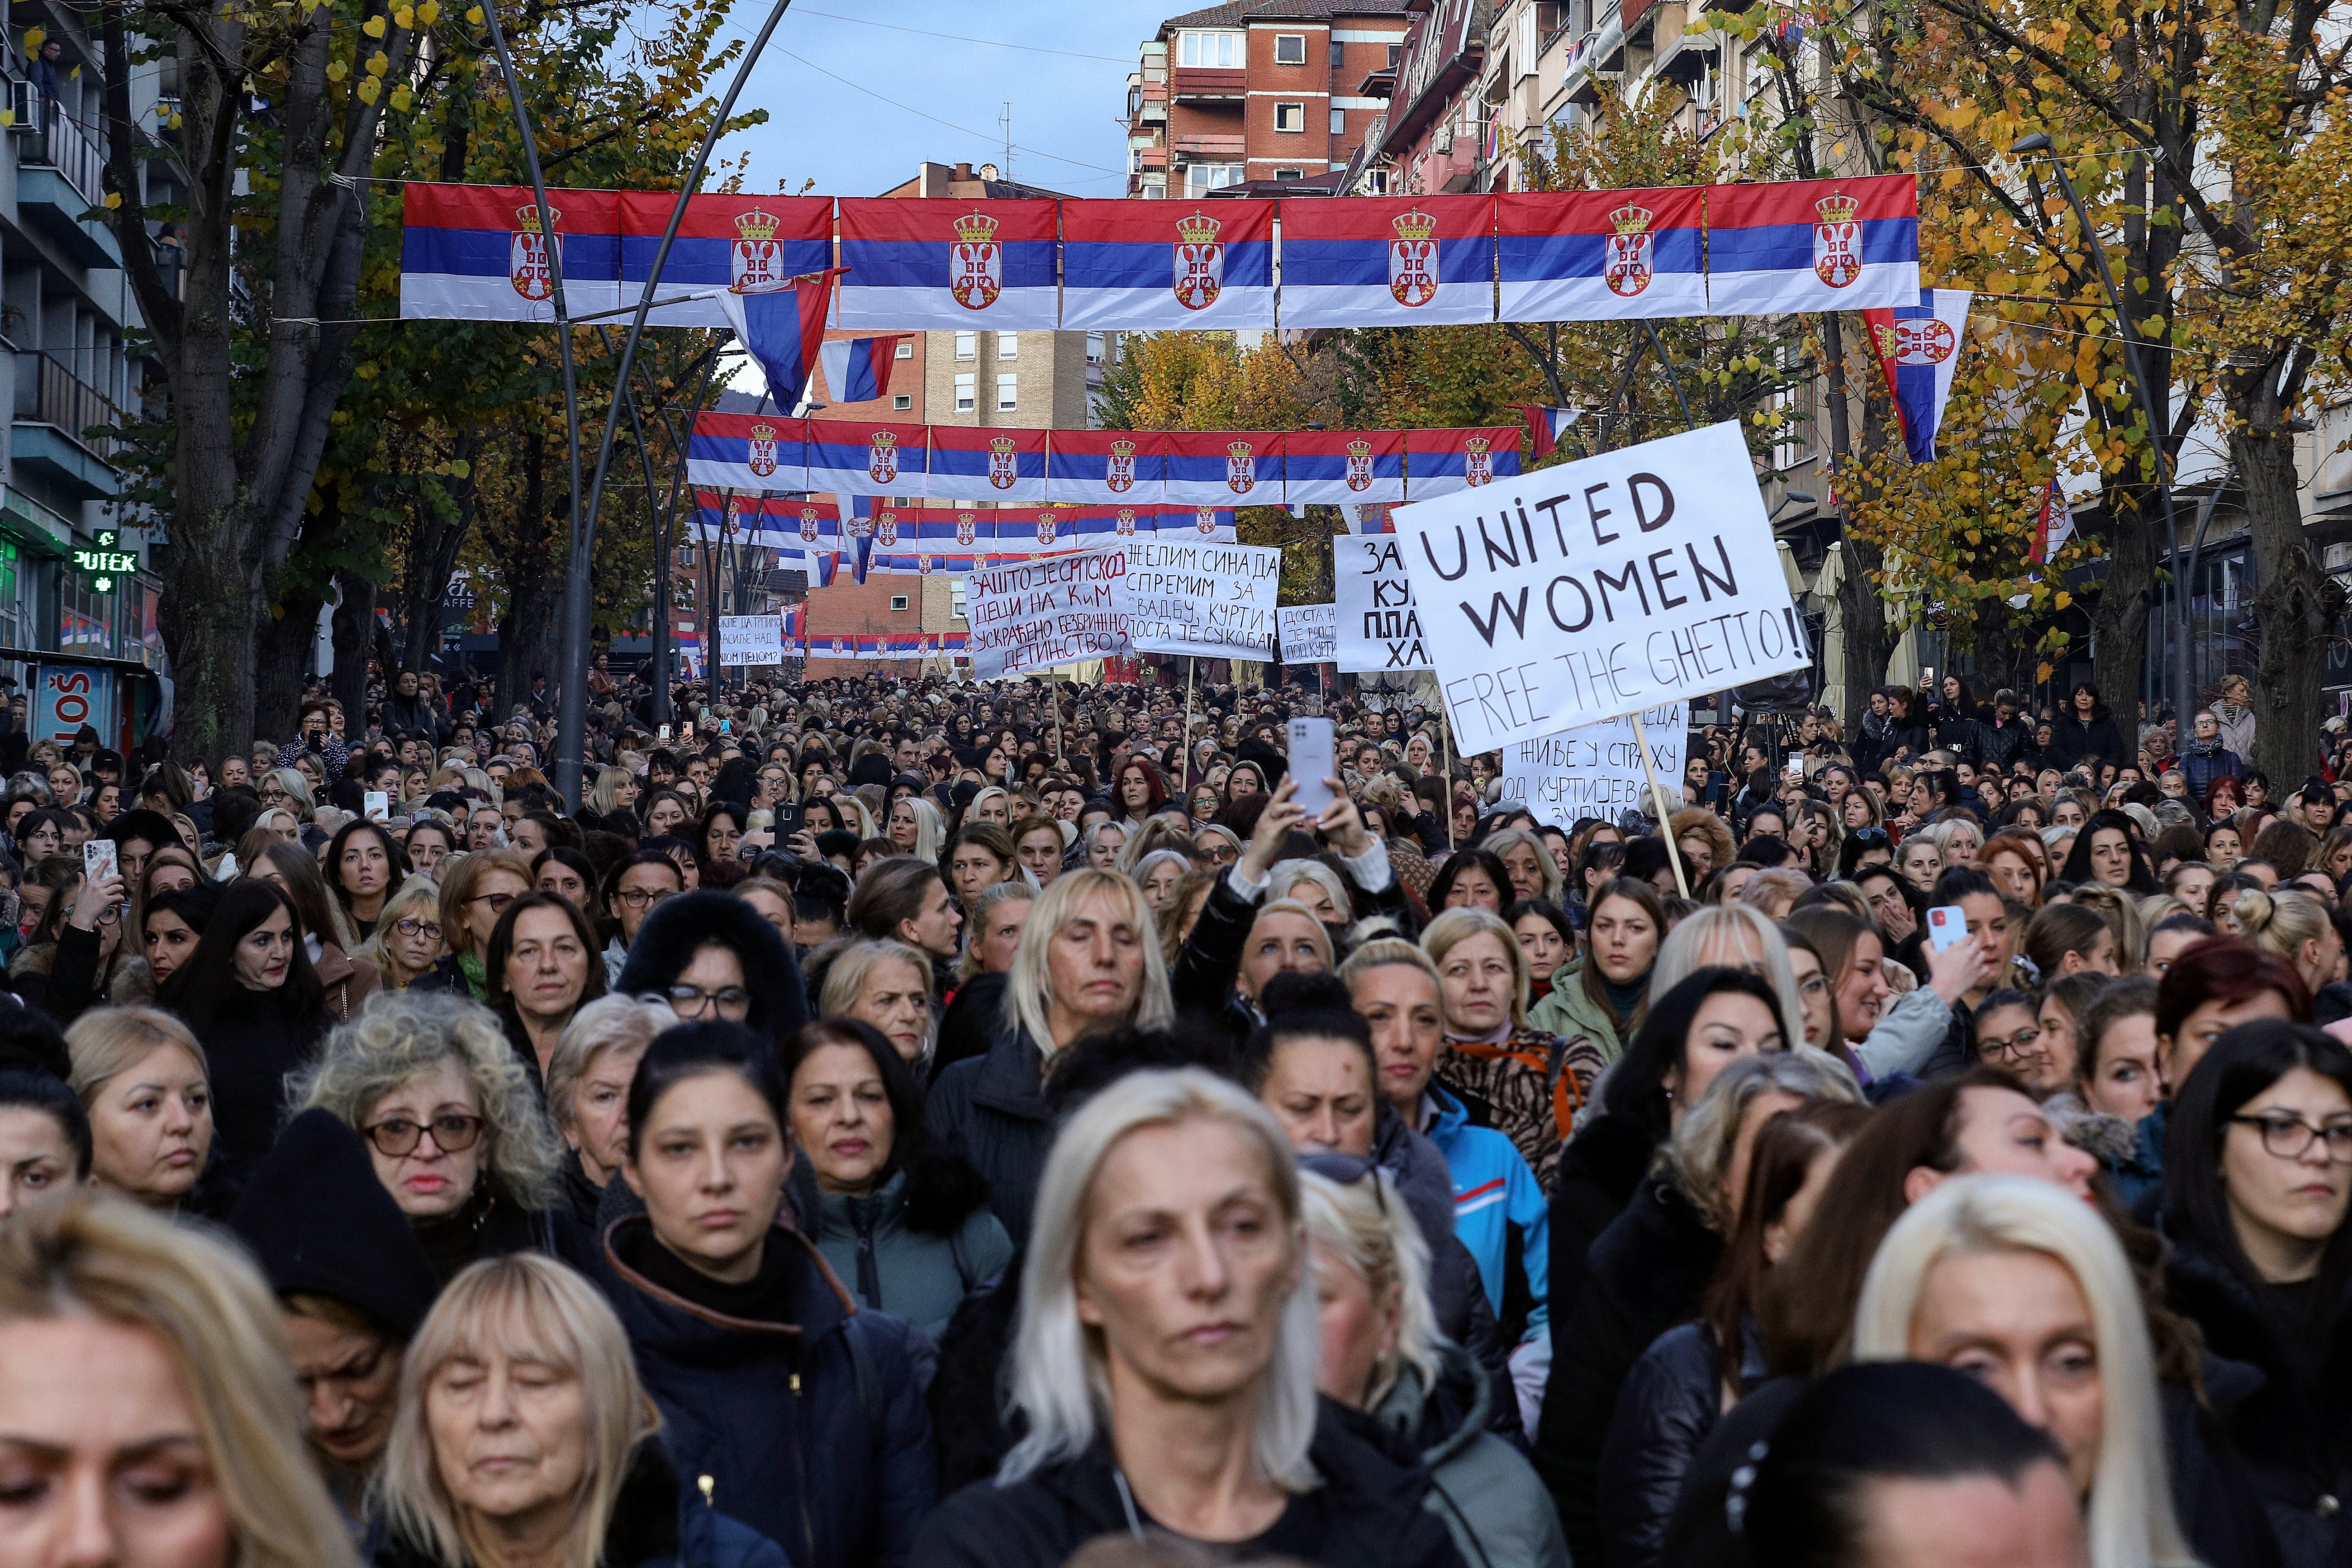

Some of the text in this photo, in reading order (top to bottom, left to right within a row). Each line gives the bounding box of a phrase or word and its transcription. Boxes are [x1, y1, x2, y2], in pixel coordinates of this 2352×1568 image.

[1126, 544, 1278, 580] ЖЕЛИМ СИНА ДА
[1362, 542, 1406, 575] ЗА
[969, 568, 1031, 599] ЗАШТО
[1059, 551, 1127, 582] СРПСКОЈ
[1126, 573, 1254, 601] СПРЕМИМ ЗА
[1373, 580, 1416, 608] КУ
[1459, 535, 1739, 648] WOMEN
[753, 617, 781, 628] ТРПИМО
[975, 597, 1022, 628] ДЕЦИ
[1030, 591, 1056, 613] НА
[1209, 603, 1264, 631] КУРТИ
[1284, 609, 1324, 627] ДОСТА
[755, 633, 774, 645] НАД
[974, 613, 1129, 652] УСКРАЋЕНО БЕЗБРИЖНО
[1203, 626, 1273, 652] СУКОБА!
[1308, 626, 1336, 639] РОПСТ
[741, 651, 778, 664] ДЕЦОМ?
[1286, 643, 1308, 659] ПОД
[1386, 639, 1434, 668] ХА
[1446, 608, 1802, 743] FREE THE GHETTO!
[1520, 739, 1577, 767] ЖИВЕ
[1585, 741, 1597, 766] У
[1503, 775, 1666, 804] ОД КУРТИЈЕВО
